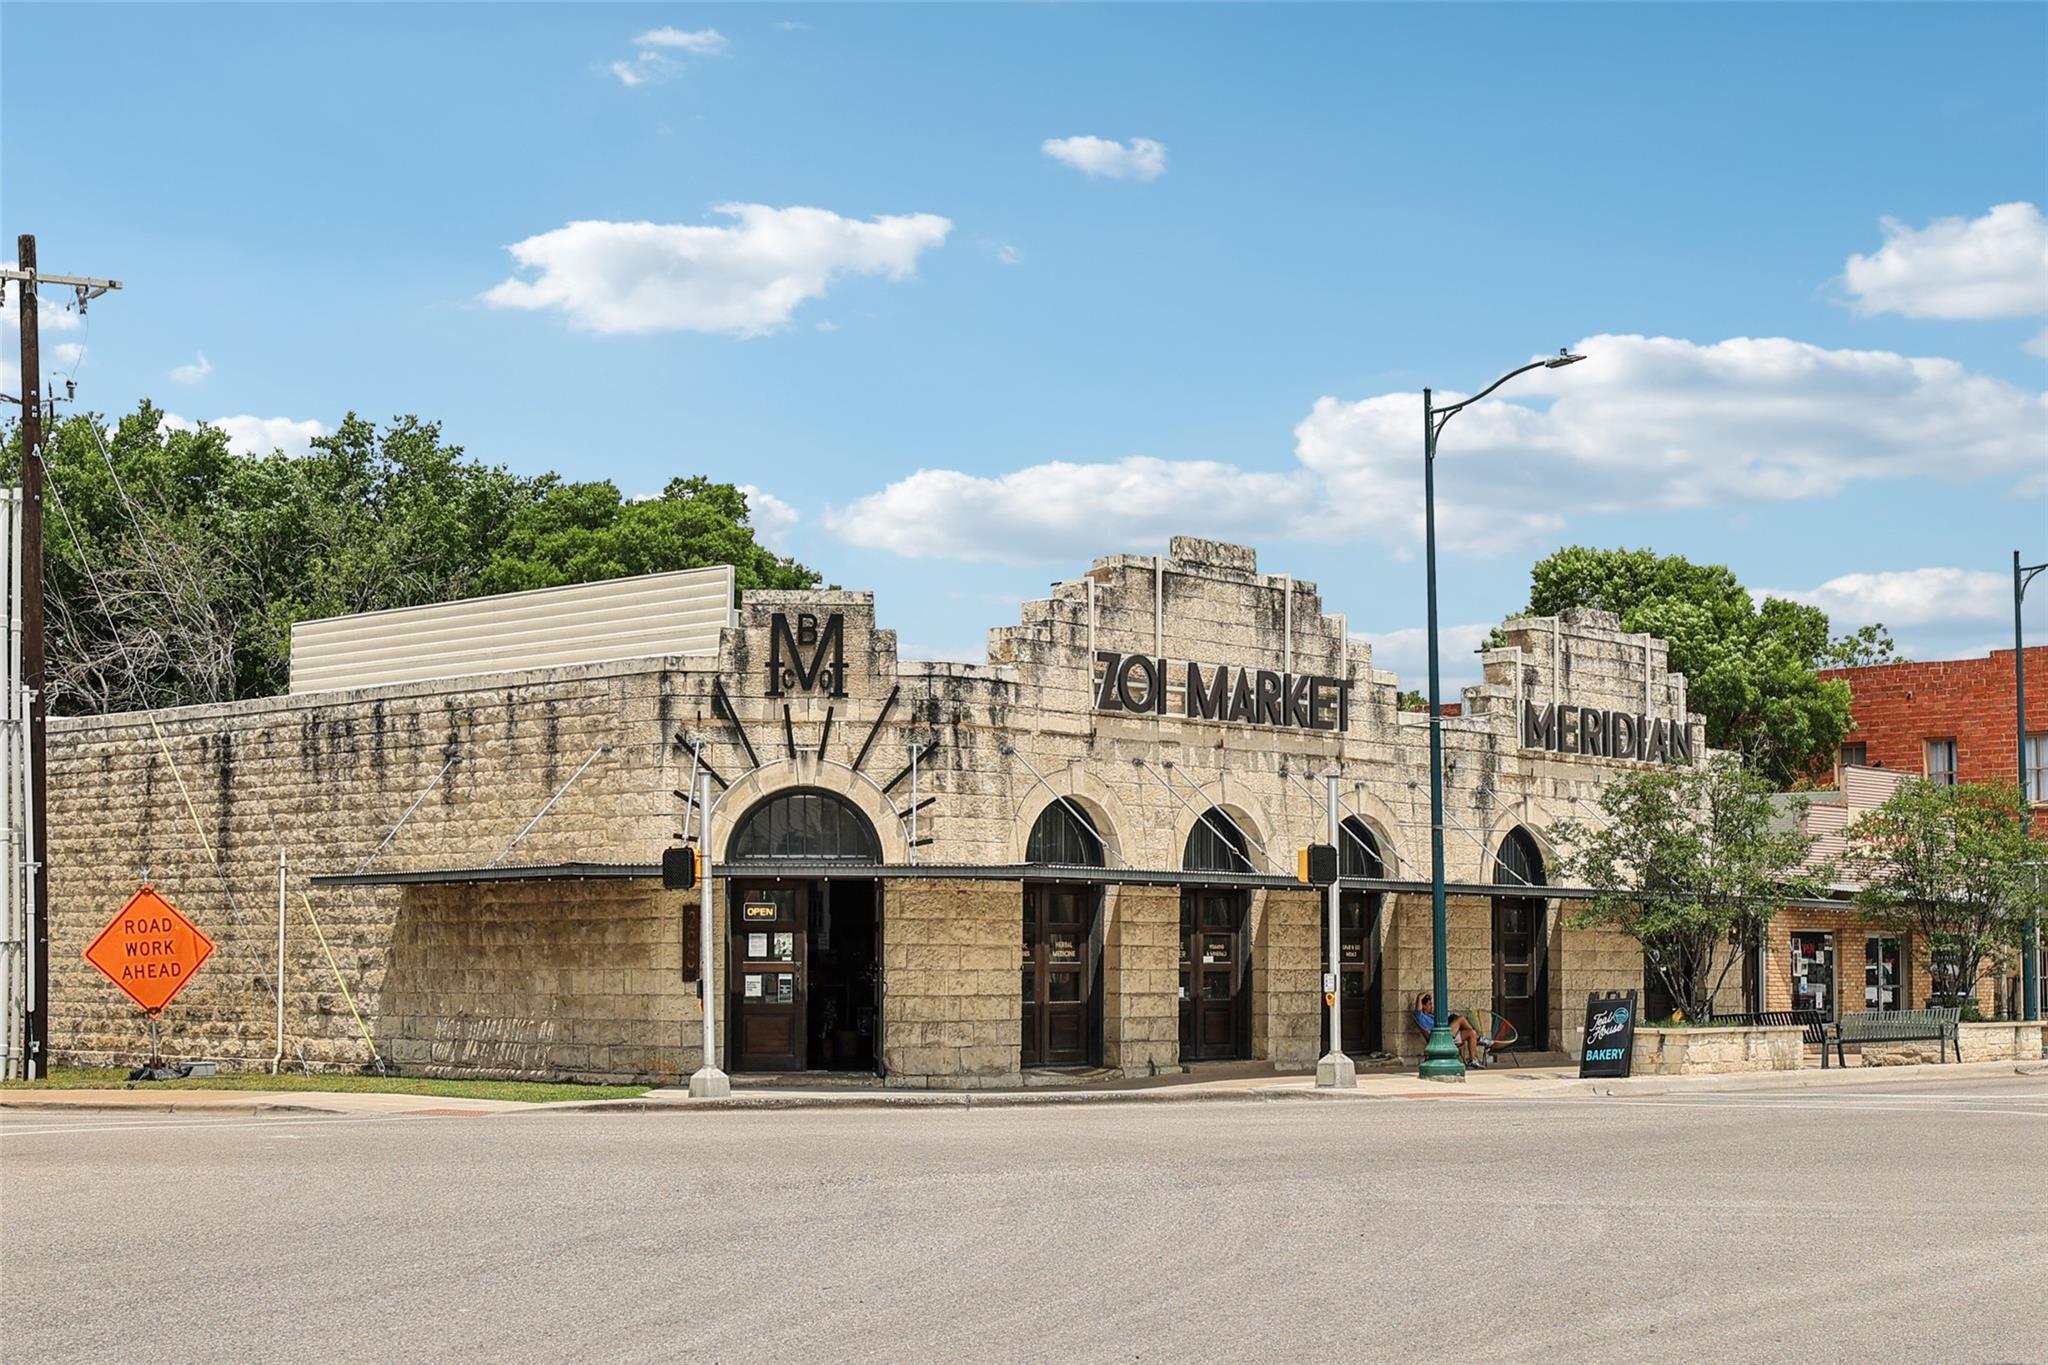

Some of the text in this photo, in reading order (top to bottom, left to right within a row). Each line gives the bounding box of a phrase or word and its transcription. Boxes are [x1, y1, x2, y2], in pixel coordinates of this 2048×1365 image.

[1097, 652, 1354, 732] ZOI MARKET
[1524, 699, 1693, 766] MERIDIAN
[746, 907, 774, 917] OPEN
[125, 918, 173, 934] ROAD
[125, 940, 175, 957] WORK
[122, 962, 182, 980] AHEAD
[1587, 1024, 1625, 1045] House
[1586, 1048, 1625, 1061] BAKERY
